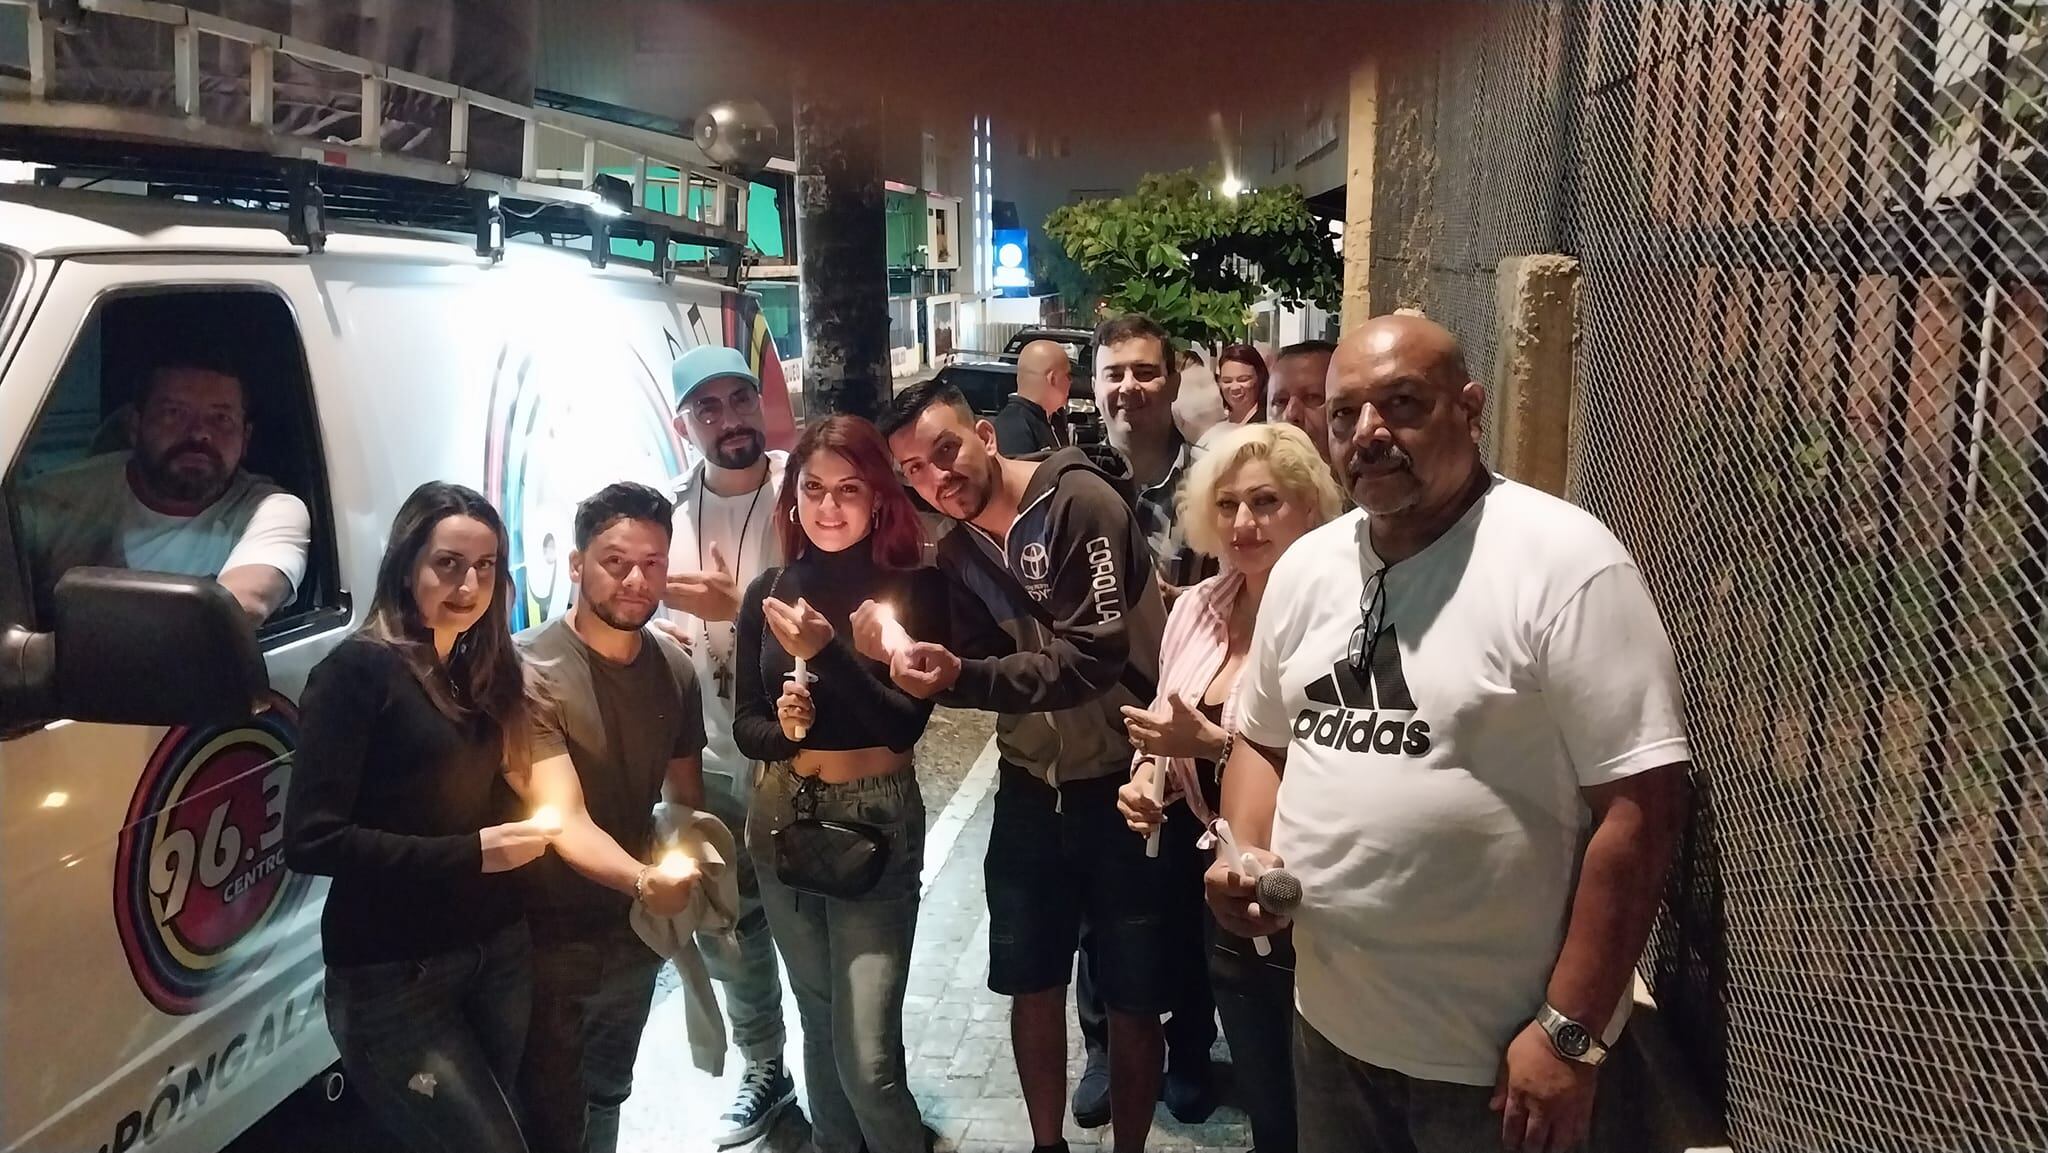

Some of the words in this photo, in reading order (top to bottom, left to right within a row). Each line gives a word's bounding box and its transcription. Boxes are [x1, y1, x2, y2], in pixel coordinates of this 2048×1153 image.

[1086, 536, 1121, 625] COROLLA
[1293, 708, 1430, 755] adidas
[149, 763, 292, 924] 96.3
[98, 979, 325, 1153] PÓNGALA
